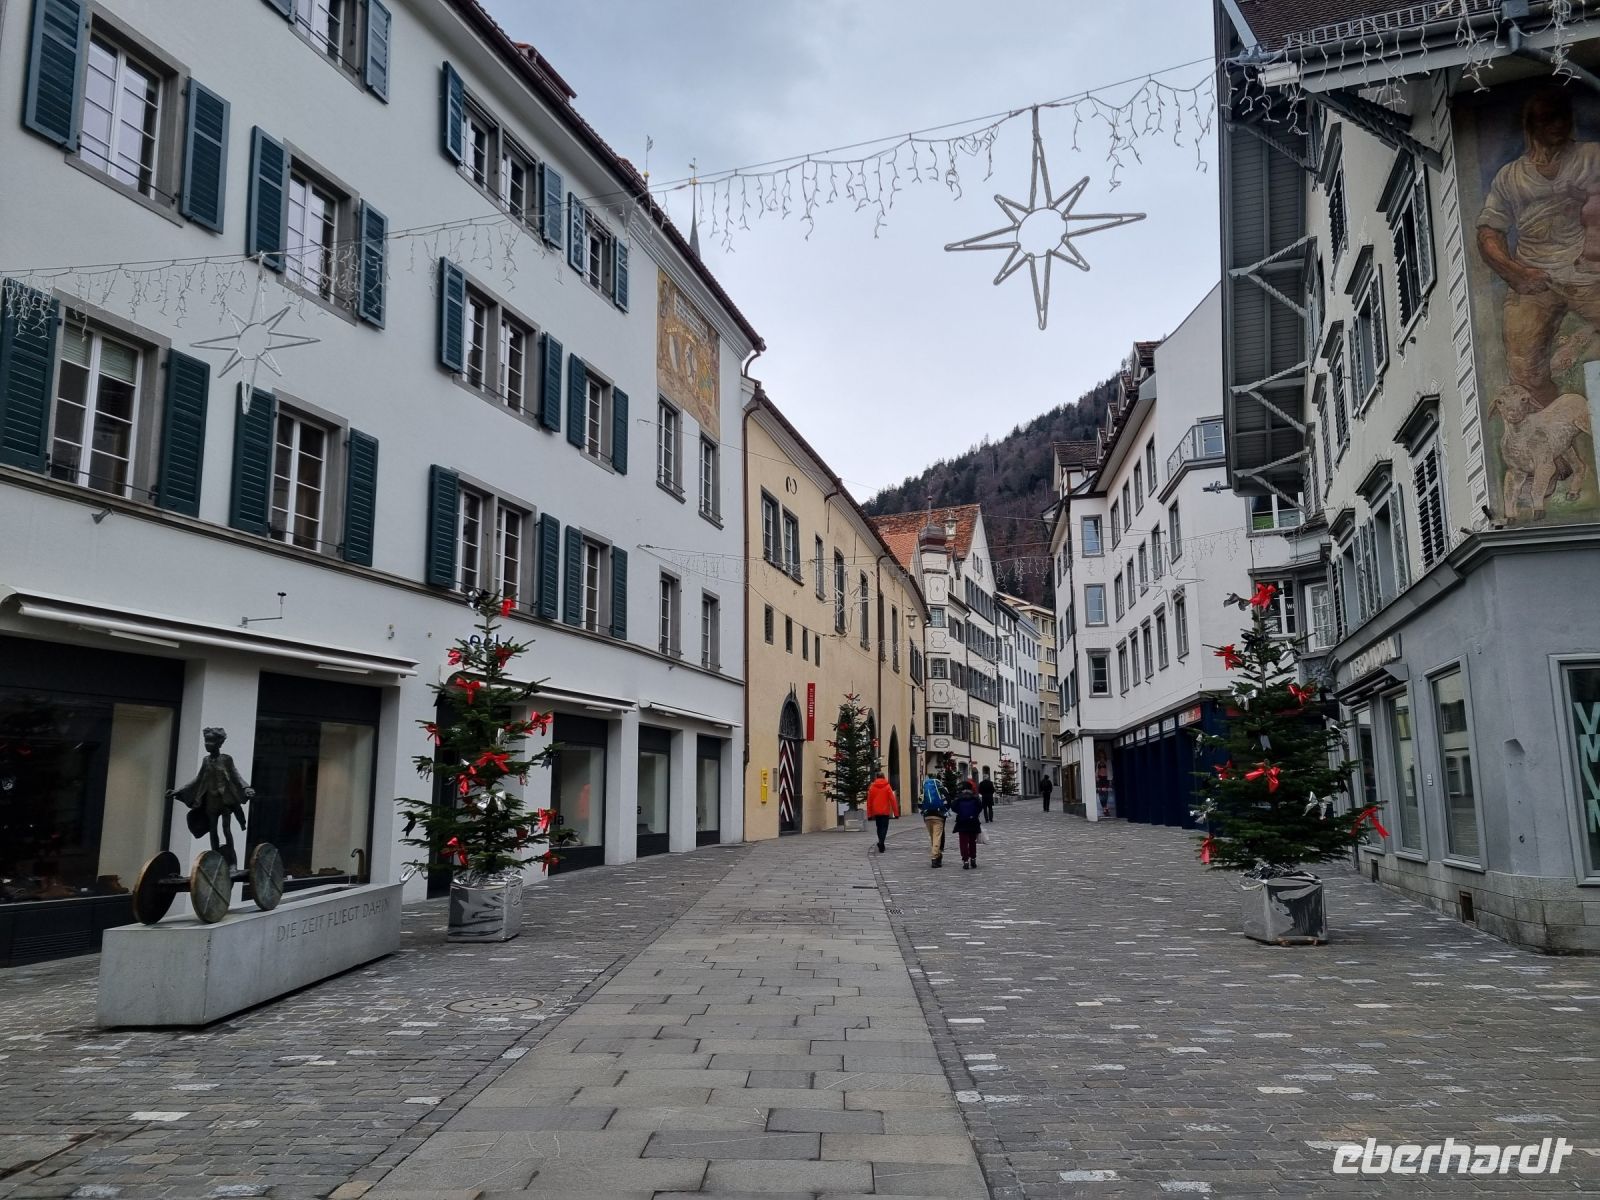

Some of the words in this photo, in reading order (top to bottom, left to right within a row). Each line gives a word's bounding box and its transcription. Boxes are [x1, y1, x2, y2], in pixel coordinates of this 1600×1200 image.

[277, 921, 298, 942] DIE
[301, 914, 325, 935] ZEIT
[327, 905, 360, 928] FLIEGT
[362, 898, 390, 918] DAHIN
